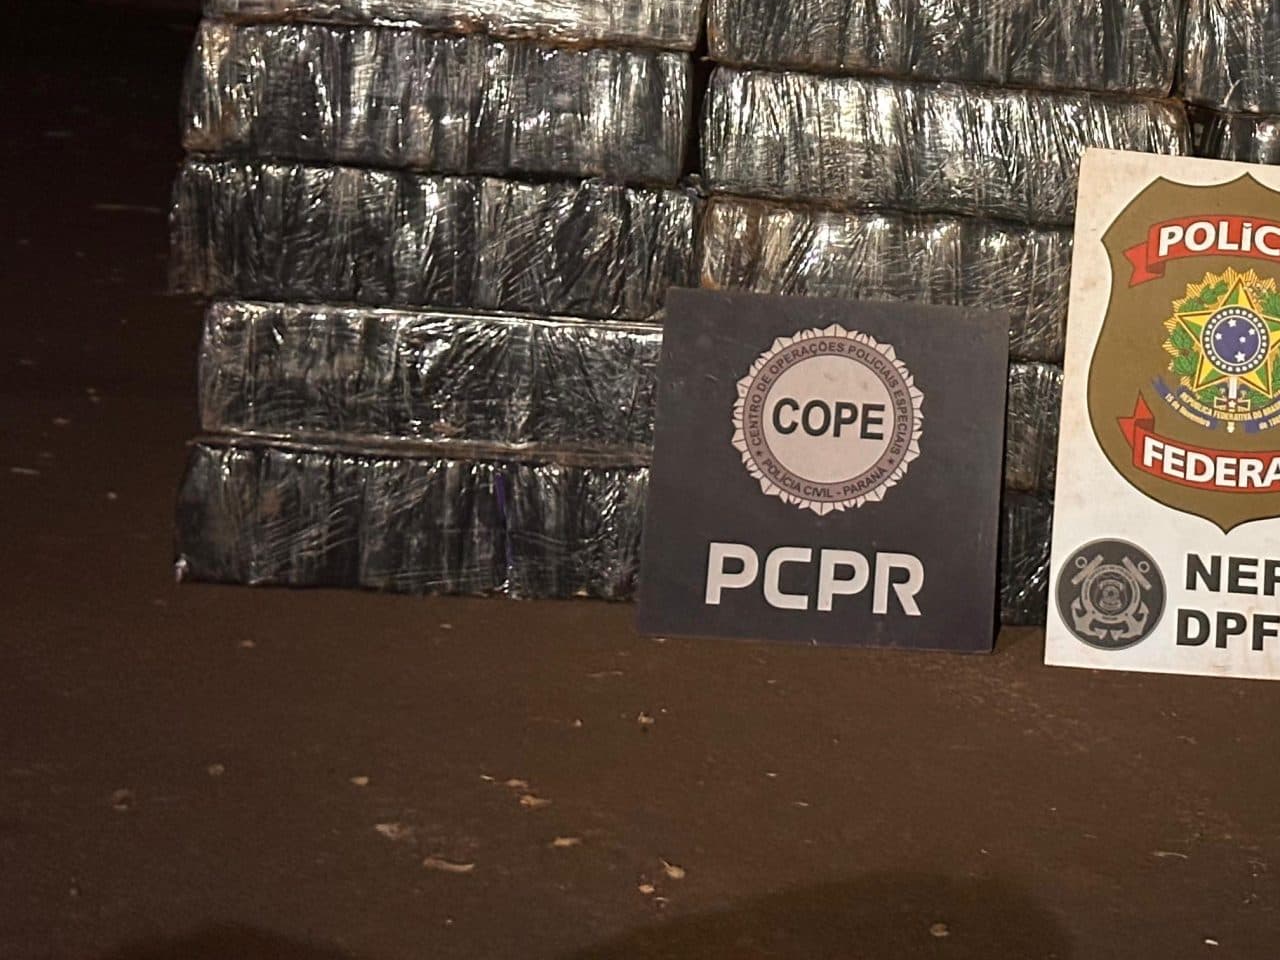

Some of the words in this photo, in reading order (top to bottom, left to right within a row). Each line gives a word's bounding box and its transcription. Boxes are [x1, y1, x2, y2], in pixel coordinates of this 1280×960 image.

[748, 392, 763, 447] CENTRO
[757, 374, 772, 393] DE
[770, 341, 845, 374] OPERAÇÕES
[848, 343, 900, 389] POLICIAIS
[890, 390, 908, 456] ESPECIAIS
[772, 397, 885, 440] COPE
[803, 486, 833, 498] CIVIL
[705, 542, 925, 616] PCPR
